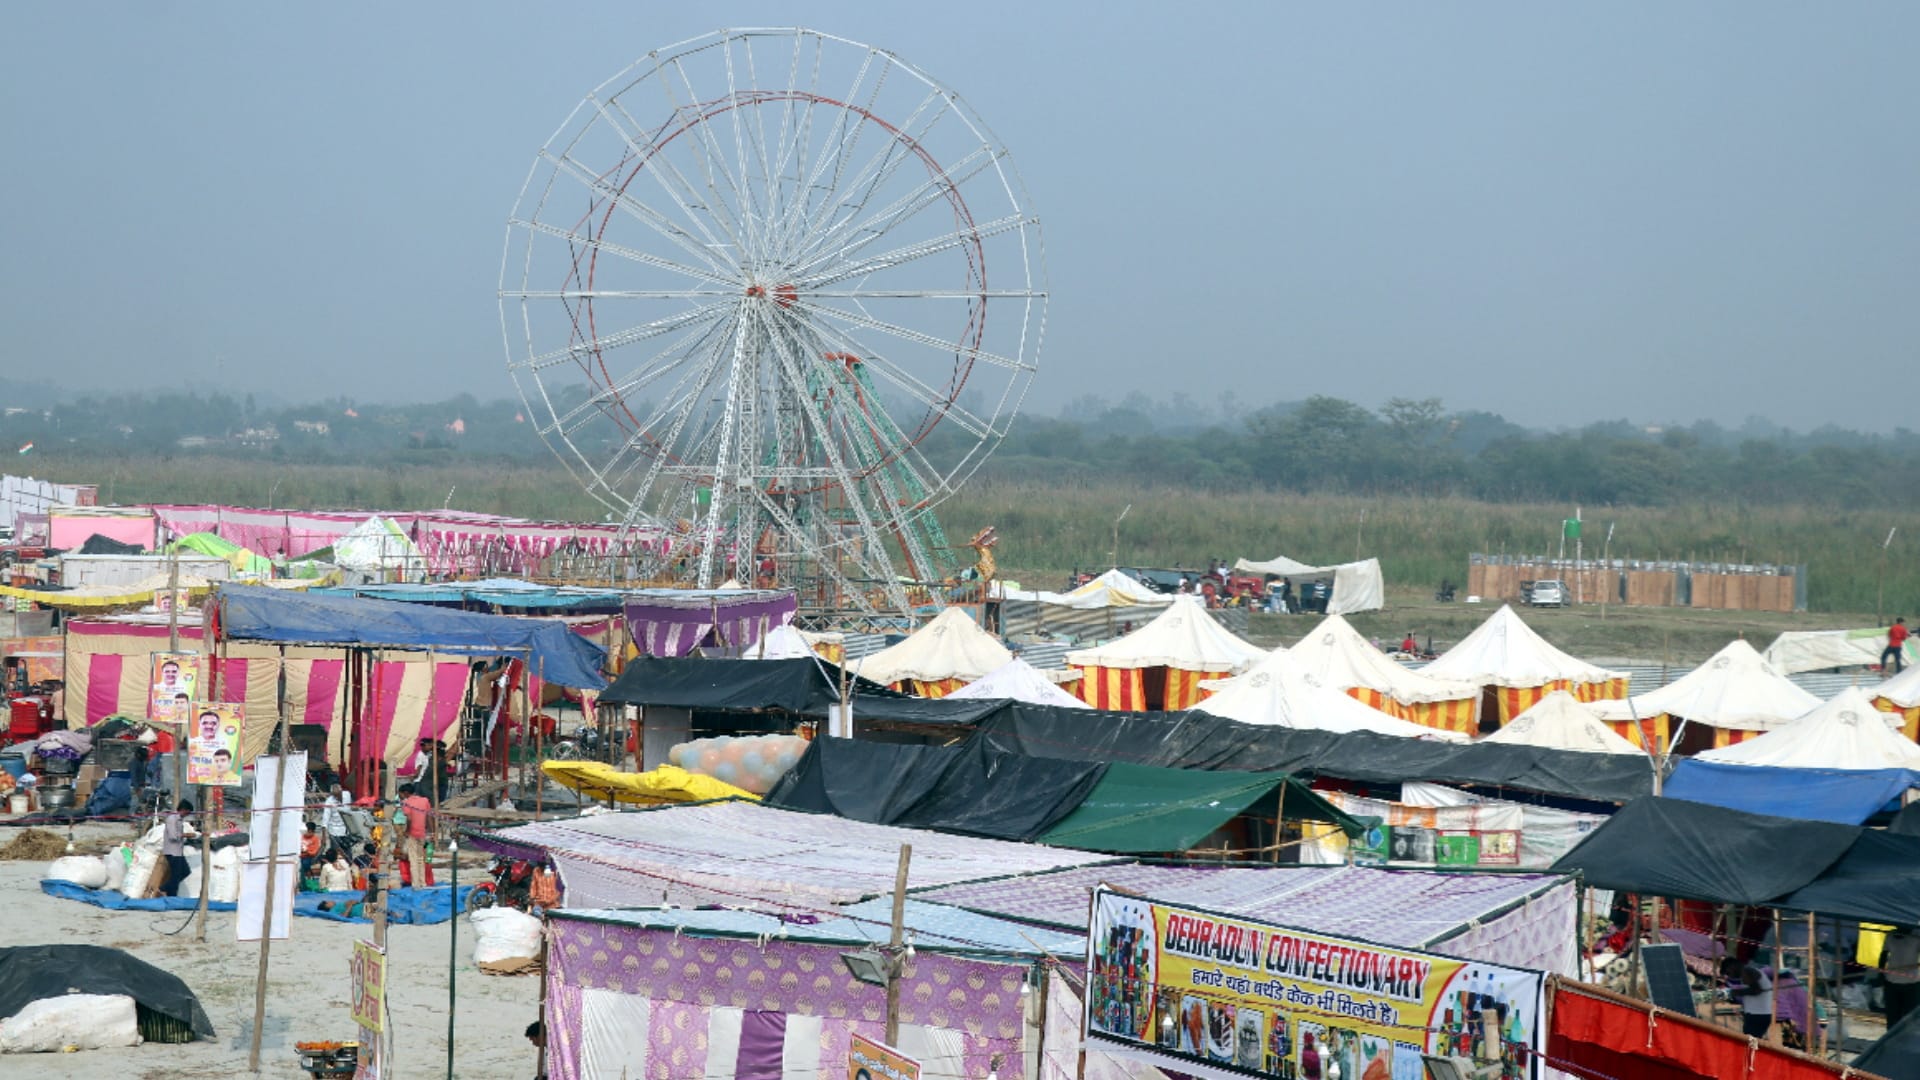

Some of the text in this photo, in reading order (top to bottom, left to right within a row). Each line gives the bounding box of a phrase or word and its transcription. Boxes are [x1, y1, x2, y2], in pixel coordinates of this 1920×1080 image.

[1164, 913, 1429, 1000] DEHRADUN CONFECTIONARY
[1192, 968, 1223, 987] हमारे
[1226, 974, 1251, 995] यहां
[1287, 984, 1315, 1006] केक
[1317, 990, 1335, 1012] भी
[1337, 993, 1376, 1020] मिलते
